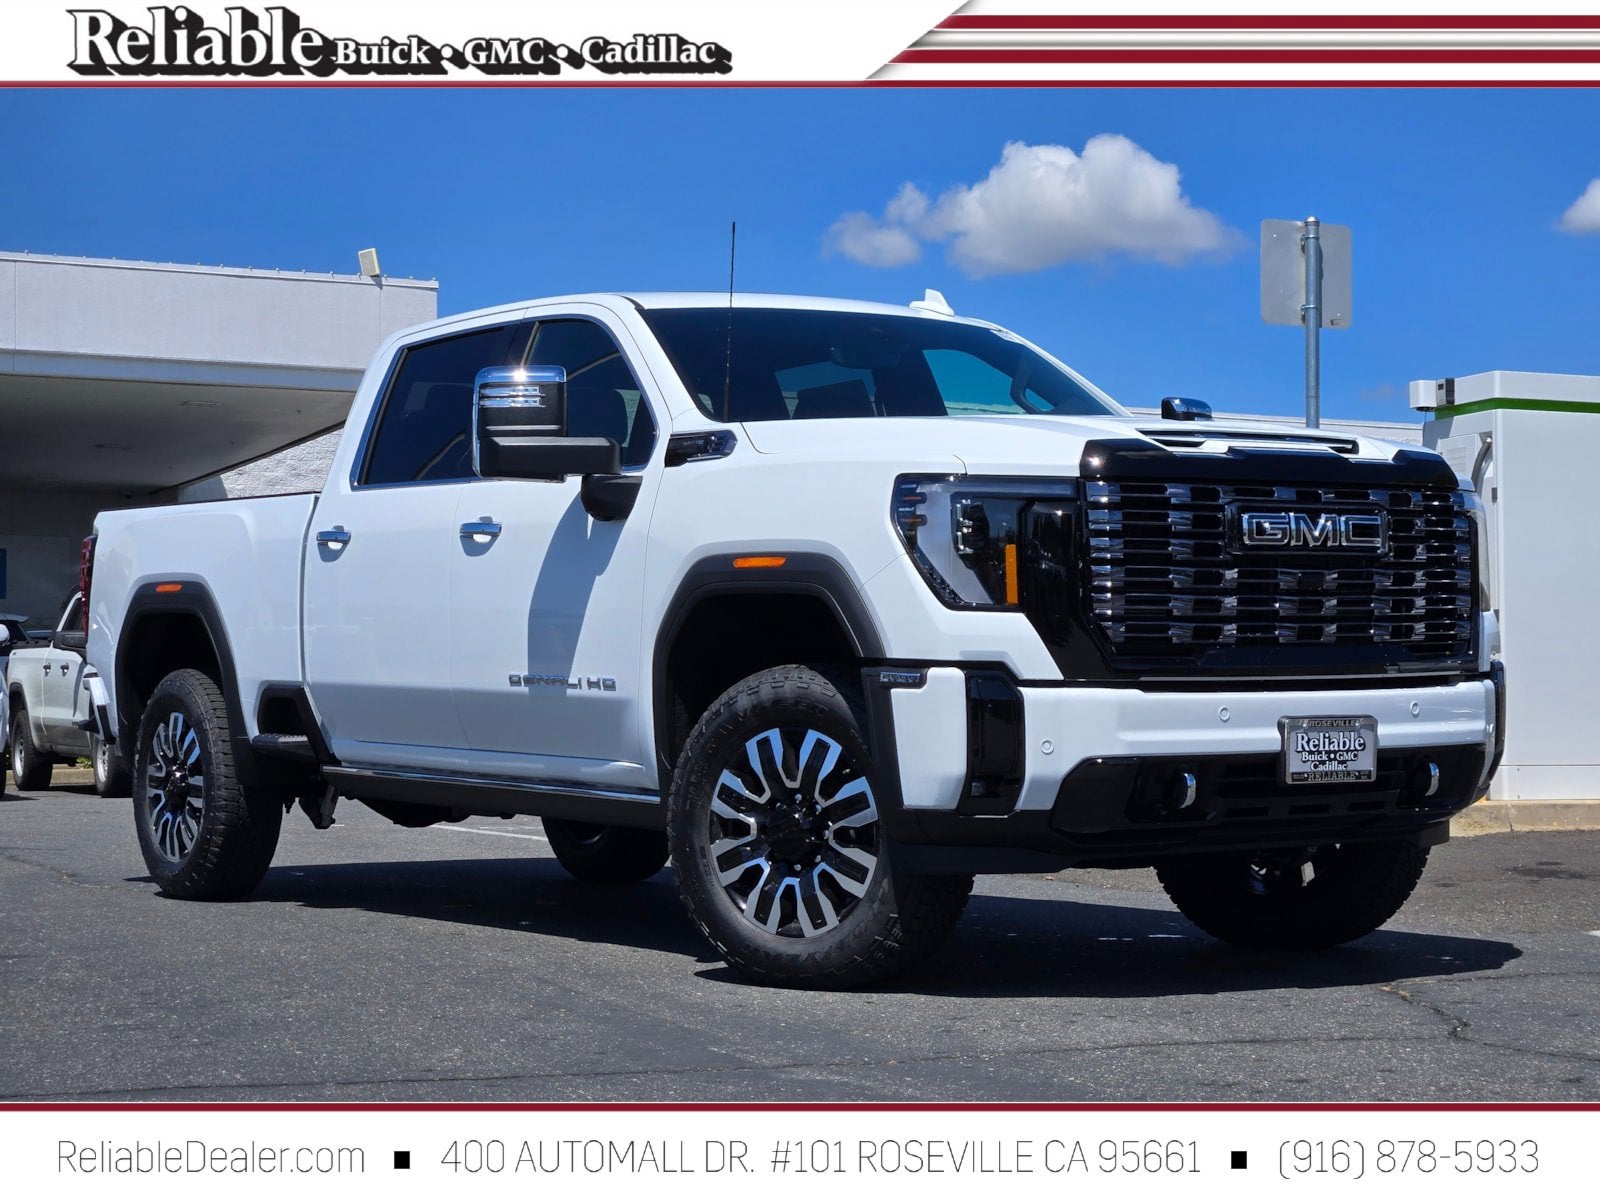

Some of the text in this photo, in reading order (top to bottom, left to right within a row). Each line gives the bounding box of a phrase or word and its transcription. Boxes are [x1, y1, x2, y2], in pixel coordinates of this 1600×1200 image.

[1242, 512, 1381, 547] GMC
[1296, 731, 1365, 752] Reliable
[1302, 751, 1358, 761] Buick GMC
[1310, 761, 1348, 771] Cadillac
[1308, 772, 1356, 781] RELIABLE
